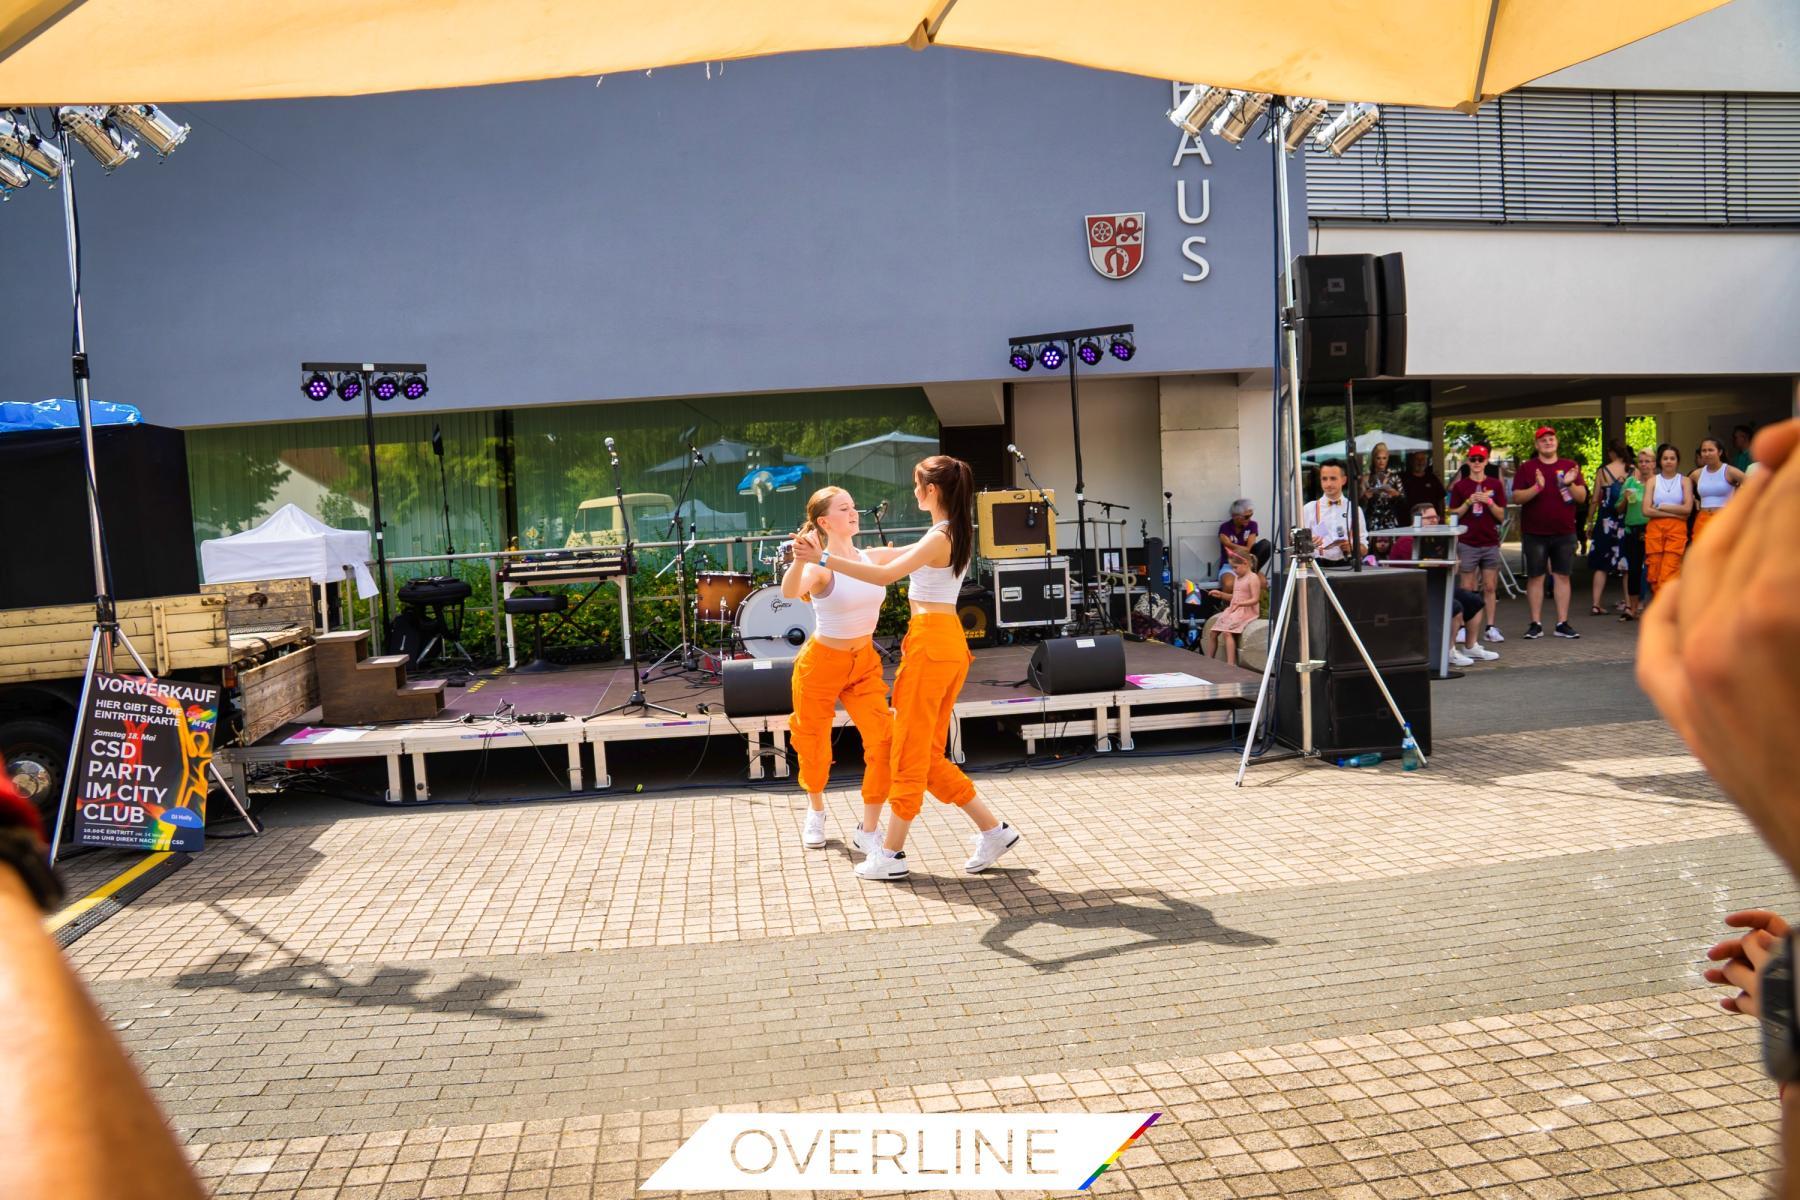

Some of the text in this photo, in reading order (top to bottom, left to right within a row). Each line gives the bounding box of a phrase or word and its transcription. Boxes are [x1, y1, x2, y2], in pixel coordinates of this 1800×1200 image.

[97, 677, 217, 703] VORVERKAUF
[95, 699, 182, 717] HIER GIBT ES DIE
[94, 709, 181, 727] EINTRITTSKARTE
[191, 719, 214, 730] MTK
[93, 728, 157, 742] Samstag 18. Mai
[91, 740, 136, 759] CSD
[88, 760, 162, 783] PARTY
[86, 782, 168, 804] IM CITY
[83, 803, 145, 823] CLUB
